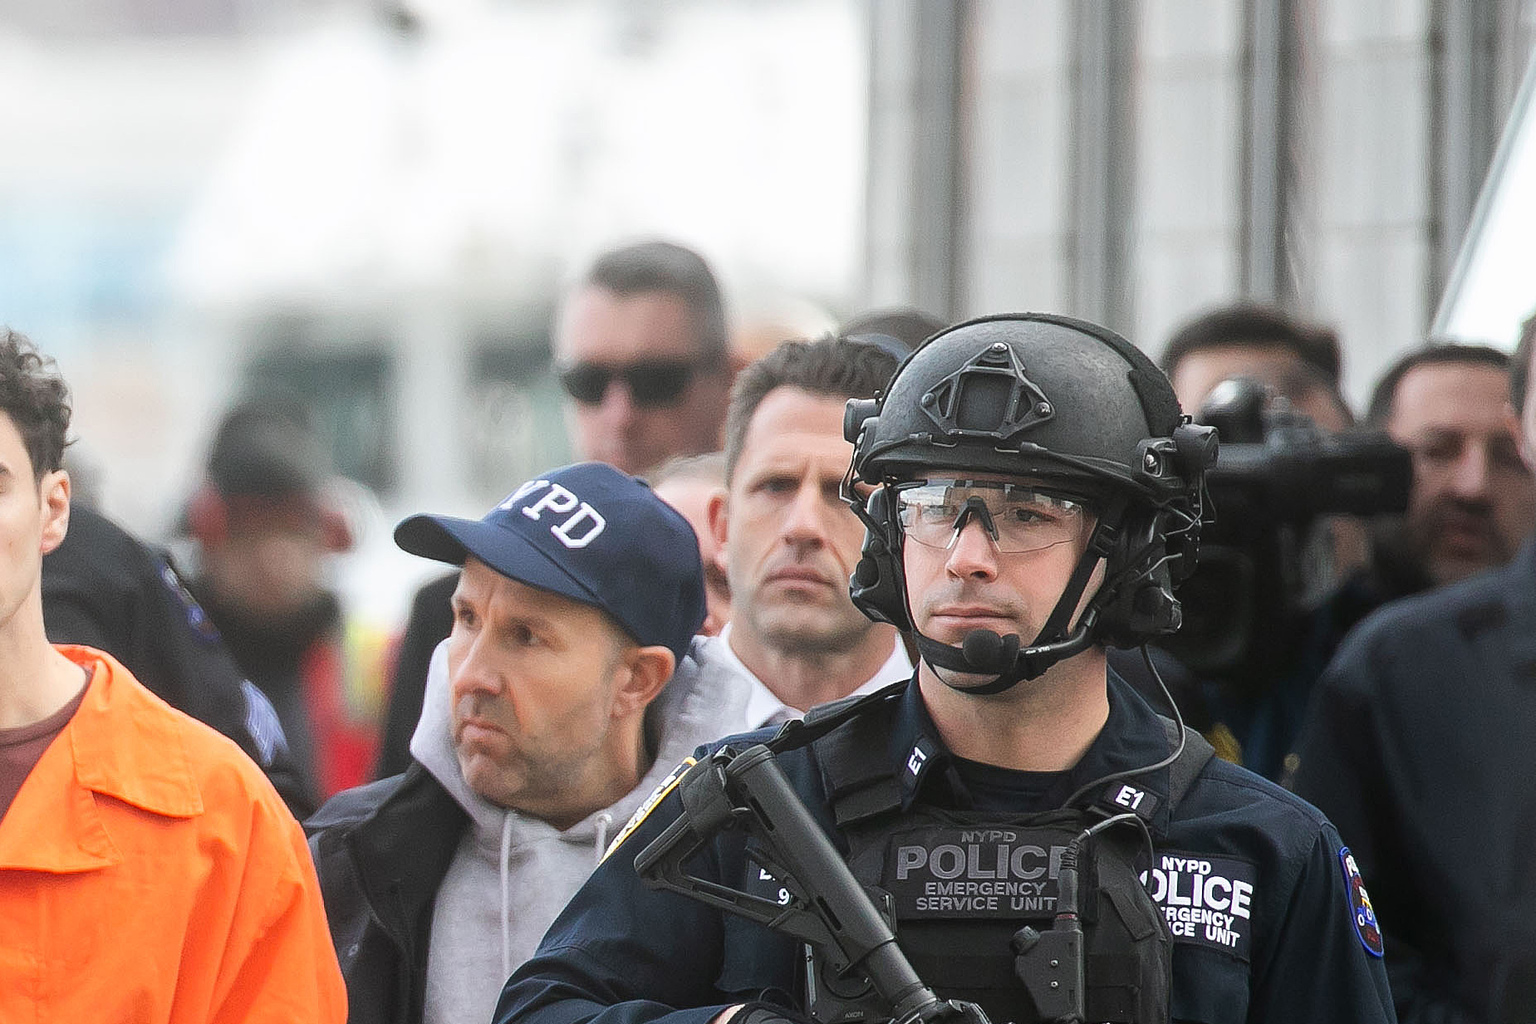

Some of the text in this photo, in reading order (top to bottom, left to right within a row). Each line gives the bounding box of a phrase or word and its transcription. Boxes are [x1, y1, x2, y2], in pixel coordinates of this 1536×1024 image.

[499, 480, 606, 548] YPD
[907, 746, 927, 776] E1
[1115, 784, 1145, 810] E1
[961, 830, 1017, 843] NYPD
[1161, 856, 1212, 875] NYPD
[925, 882, 1047, 896] EMERGENCY
[1139, 868, 1254, 920] OLICE
[916, 897, 1058, 911] SERVICE UNIT
[1160, 906, 1235, 931] RGENCY
[1205, 924, 1241, 948] UNIT
